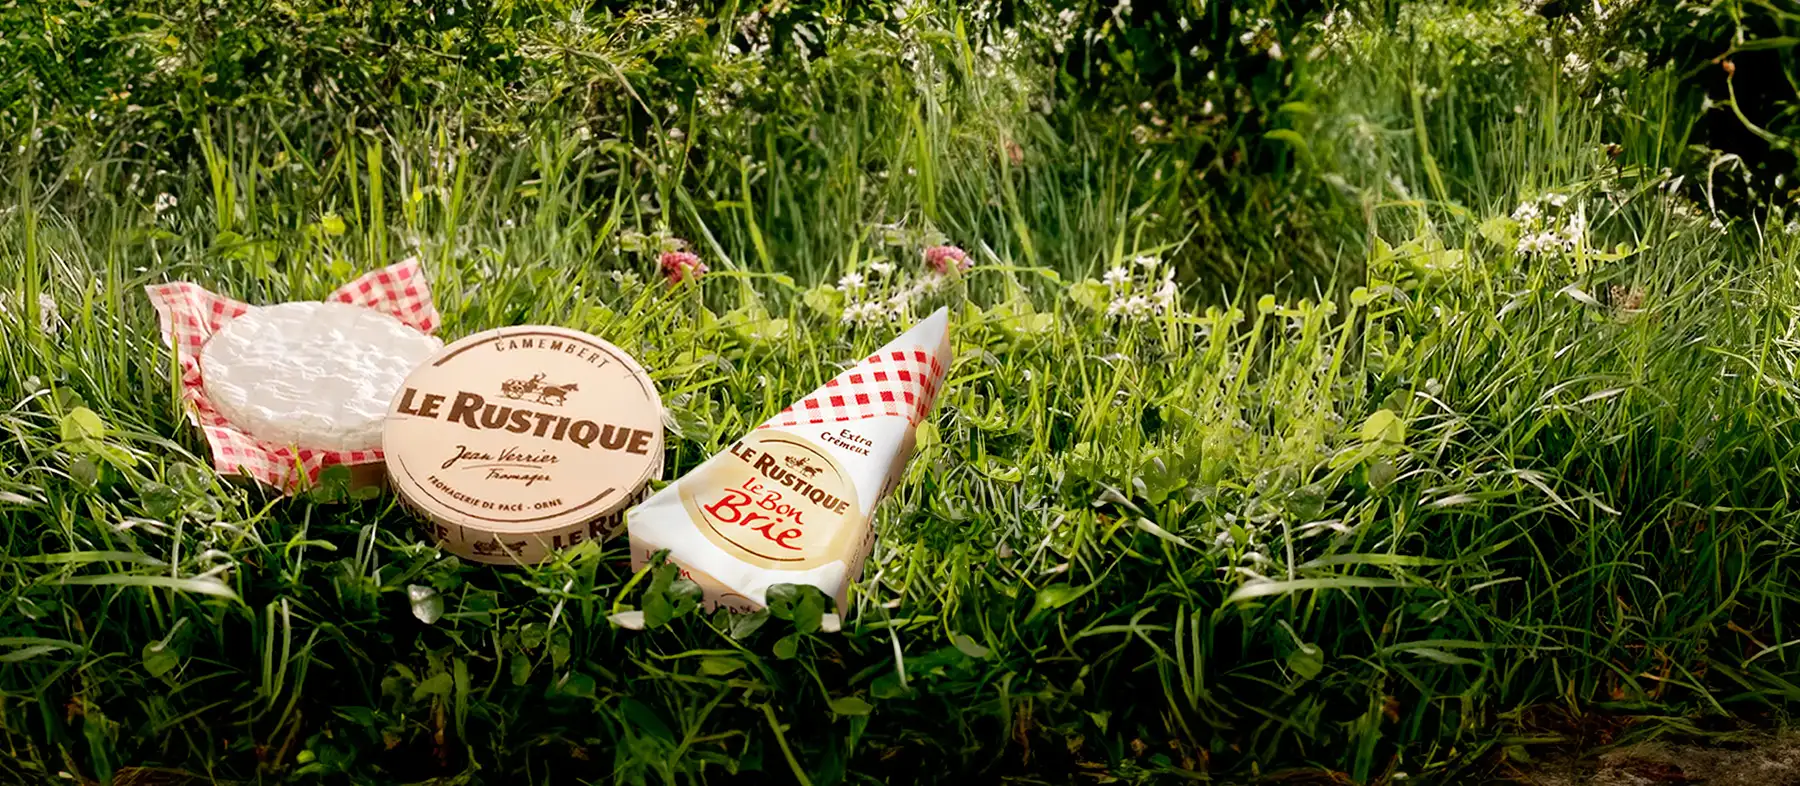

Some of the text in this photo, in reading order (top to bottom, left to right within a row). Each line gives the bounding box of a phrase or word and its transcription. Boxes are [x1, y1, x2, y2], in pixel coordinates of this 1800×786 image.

[496, 338, 610, 368] CAMEMBERT
[397, 387, 654, 456] LE RUSTIQUE
[820, 431, 871, 457] Crémeux
[839, 429, 873, 447] Extra
[441, 445, 560, 470] Jean Verrier
[485, 468, 552, 487] Fromager
[730, 441, 850, 516] LE RUSTIQUE
[427, 475, 480, 506] FROMAGERIE
[482, 501, 493, 510] DE
[498, 503, 523, 512] PACÉ
[534, 498, 563, 510] ORNE
[742, 477, 804, 525] Le Bon
[703, 488, 803, 551] Brie
[552, 530, 583, 552] LE
